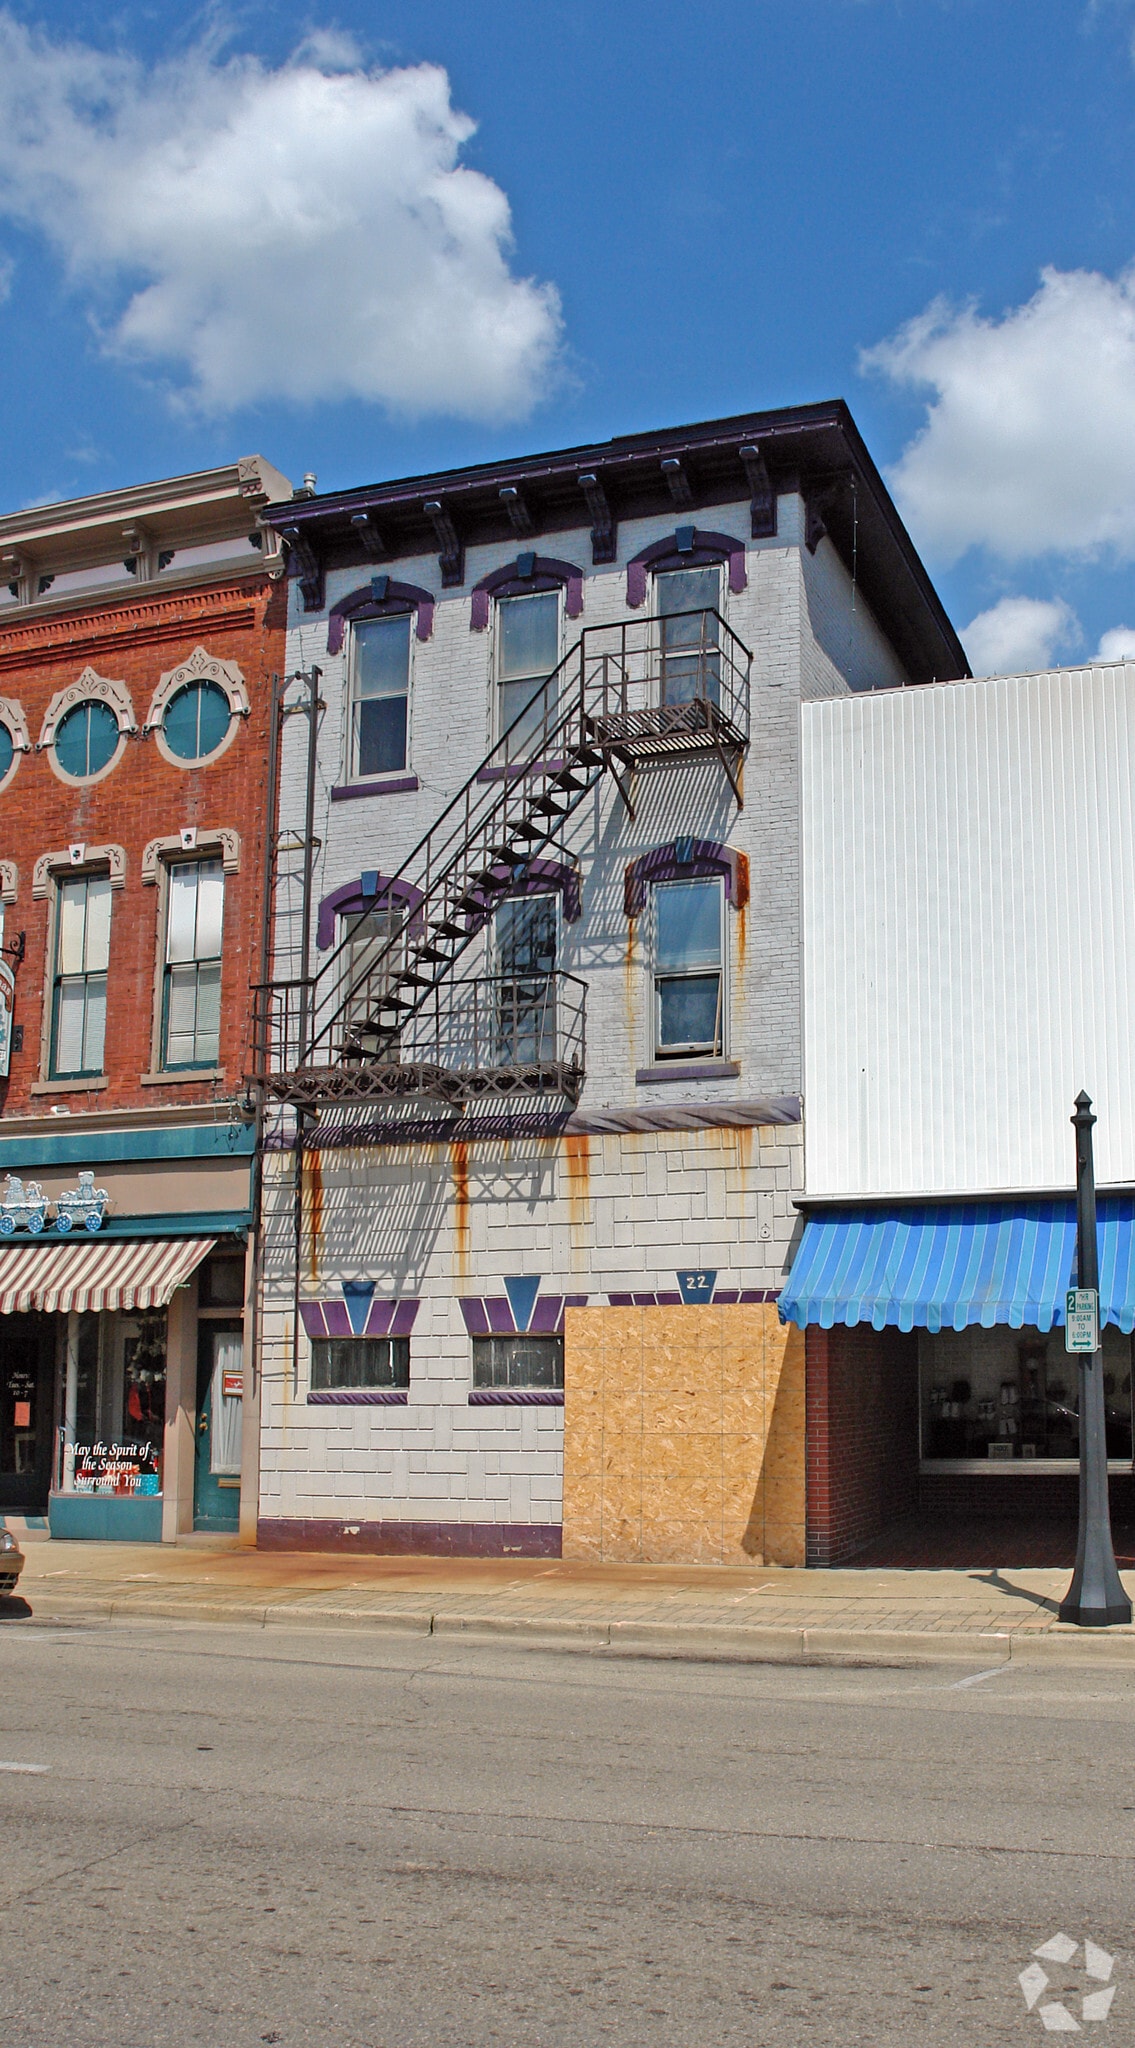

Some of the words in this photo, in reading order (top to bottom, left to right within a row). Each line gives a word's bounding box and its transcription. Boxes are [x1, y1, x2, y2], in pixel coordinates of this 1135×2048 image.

[686, 1276, 709, 1289] 22
[1068, 1295, 1075, 1310] 2
[65, 1442, 91, 1458] May
[92, 1441, 107, 1456] the
[109, 1443, 138, 1461] Spirit
[139, 1441, 151, 1461] of
[82, 1456, 97, 1471] the
[98, 1458, 133, 1471] Season
[74, 1473, 120, 1487] Surround
[123, 1474, 142, 1487] You
